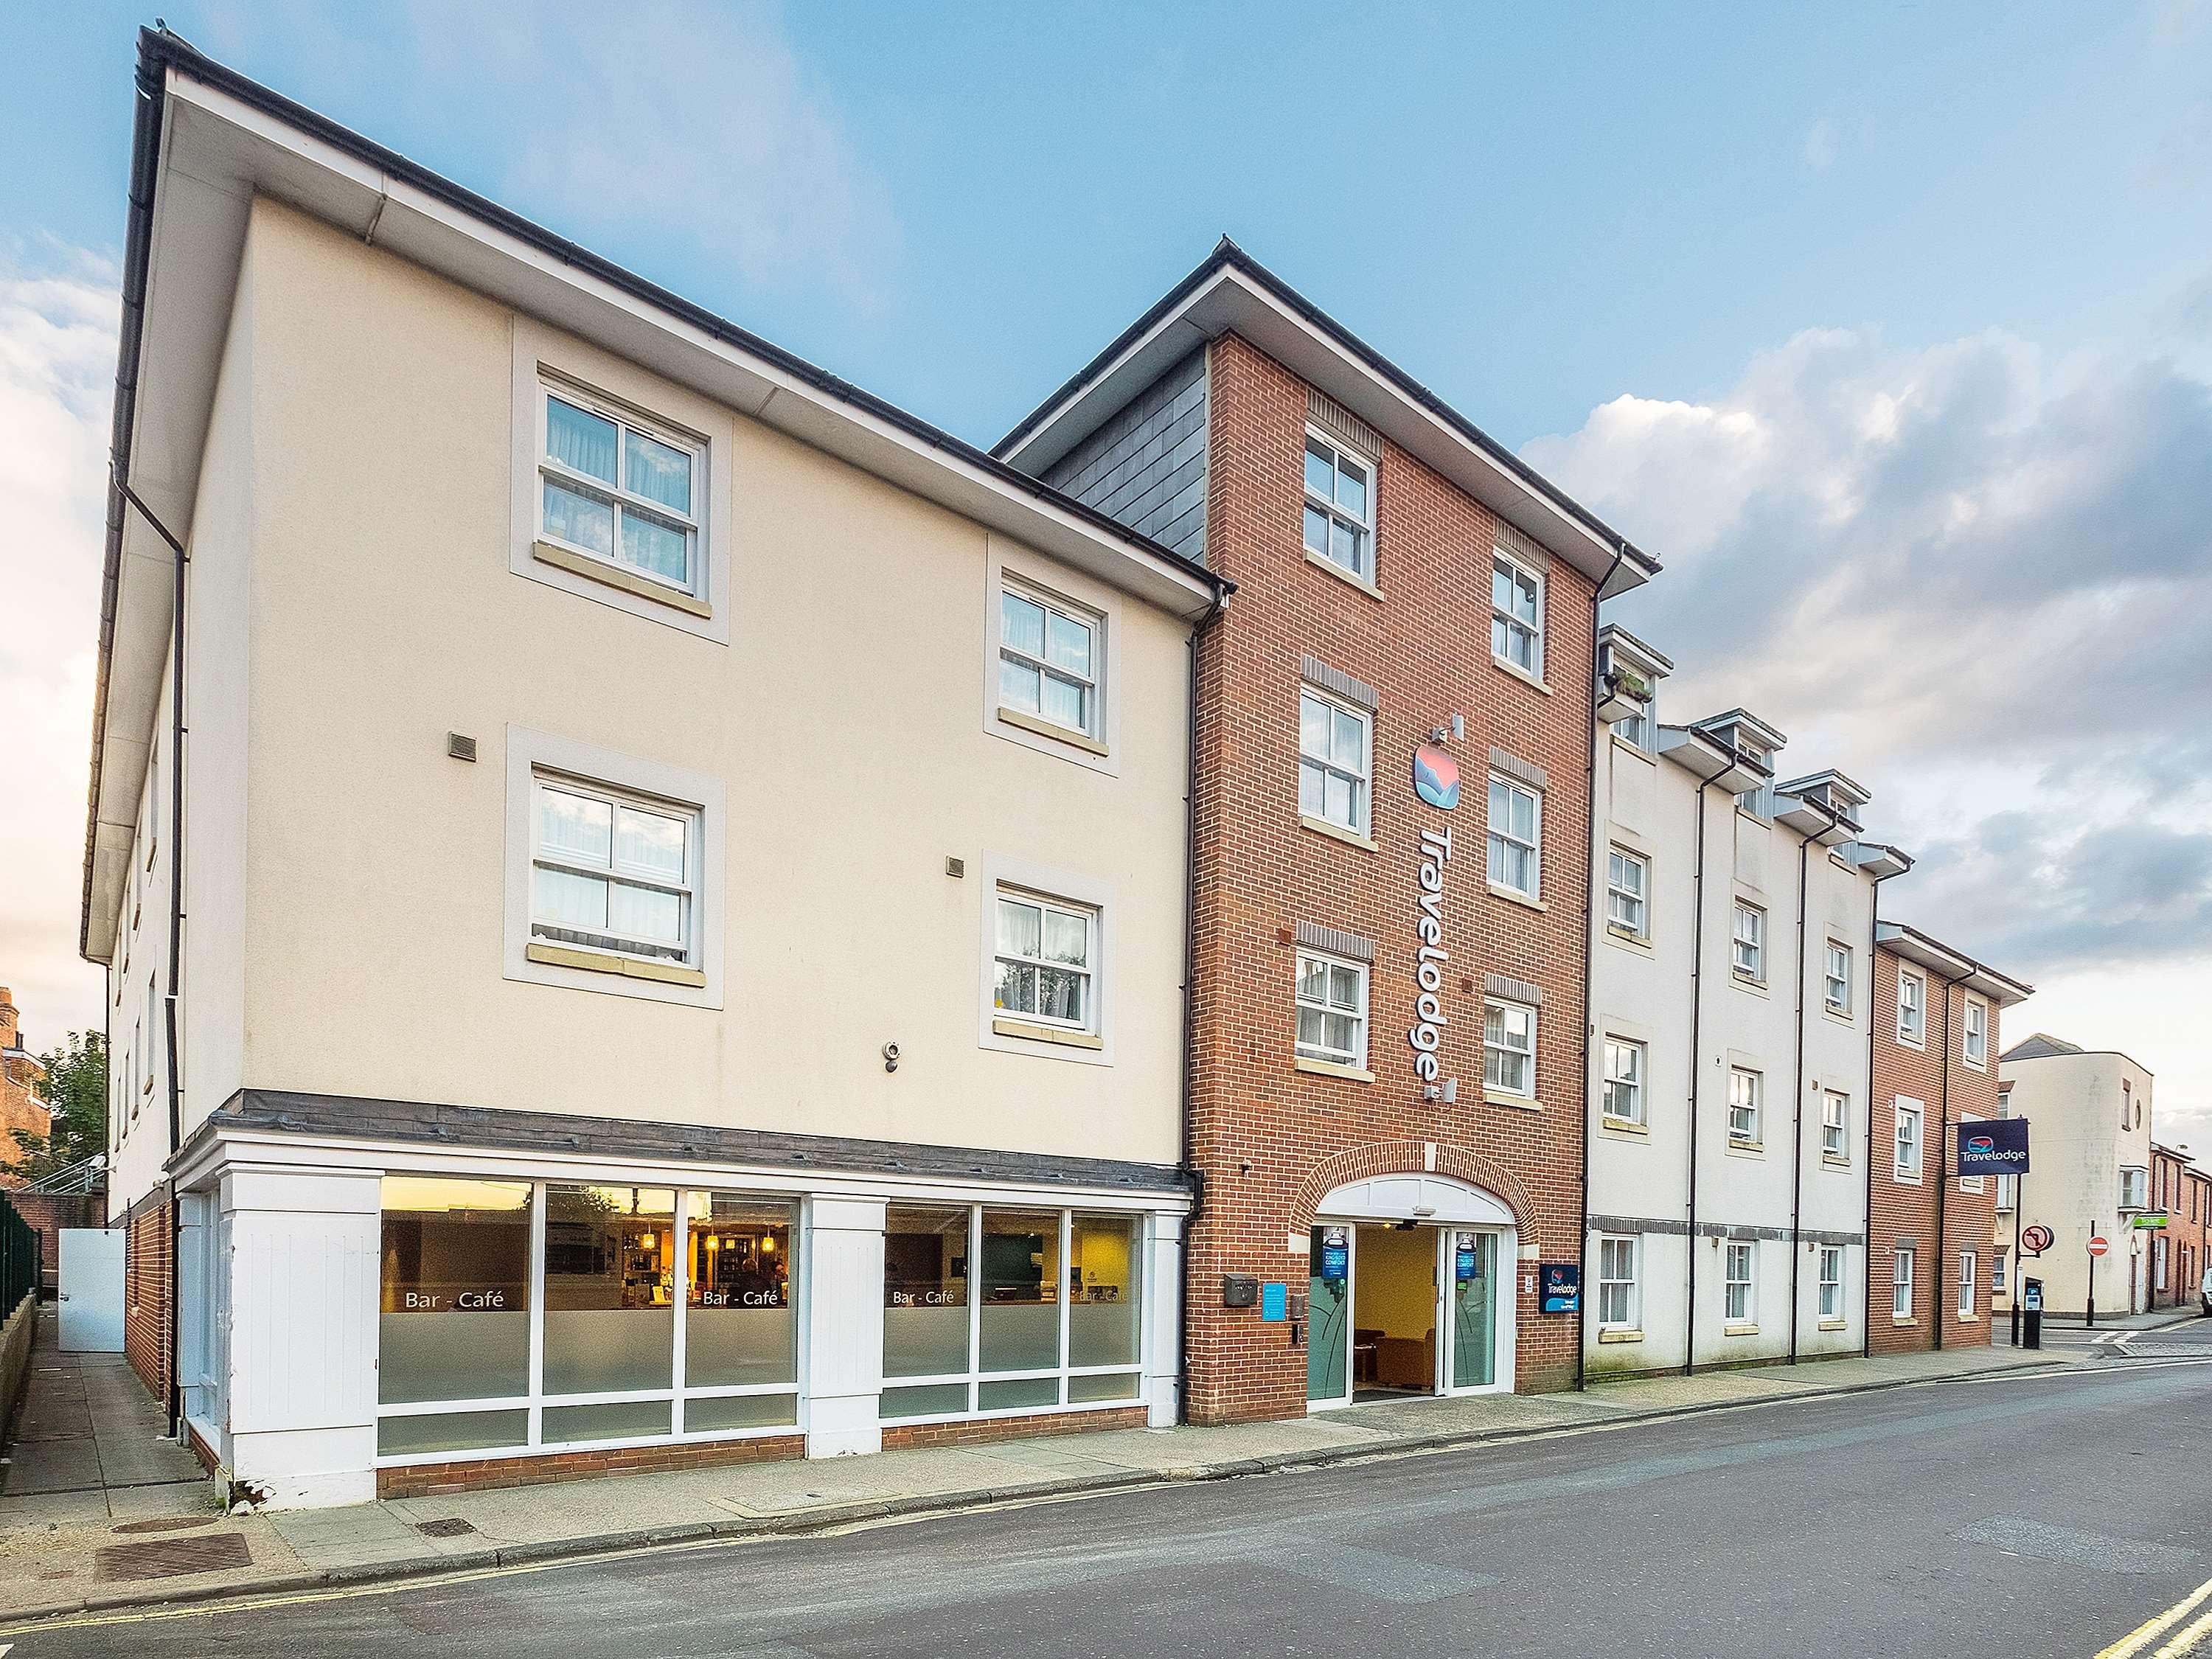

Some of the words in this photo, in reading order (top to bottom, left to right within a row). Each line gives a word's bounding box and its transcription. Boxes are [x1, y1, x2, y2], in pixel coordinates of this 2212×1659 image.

[1410, 826, 1452, 1082] Travelodge
[1961, 1150, 2026, 1162] Travelodge
[1079, 1291, 1097, 1301] Bar
[1548, 1284, 1577, 1295] Travelodge
[406, 1293, 440, 1307] Bar
[459, 1290, 504, 1307] Café
[703, 1291, 730, 1304] Bar
[743, 1290, 778, 1304] Café
[893, 1291, 916, 1304] Bar
[925, 1290, 954, 1303] Café
